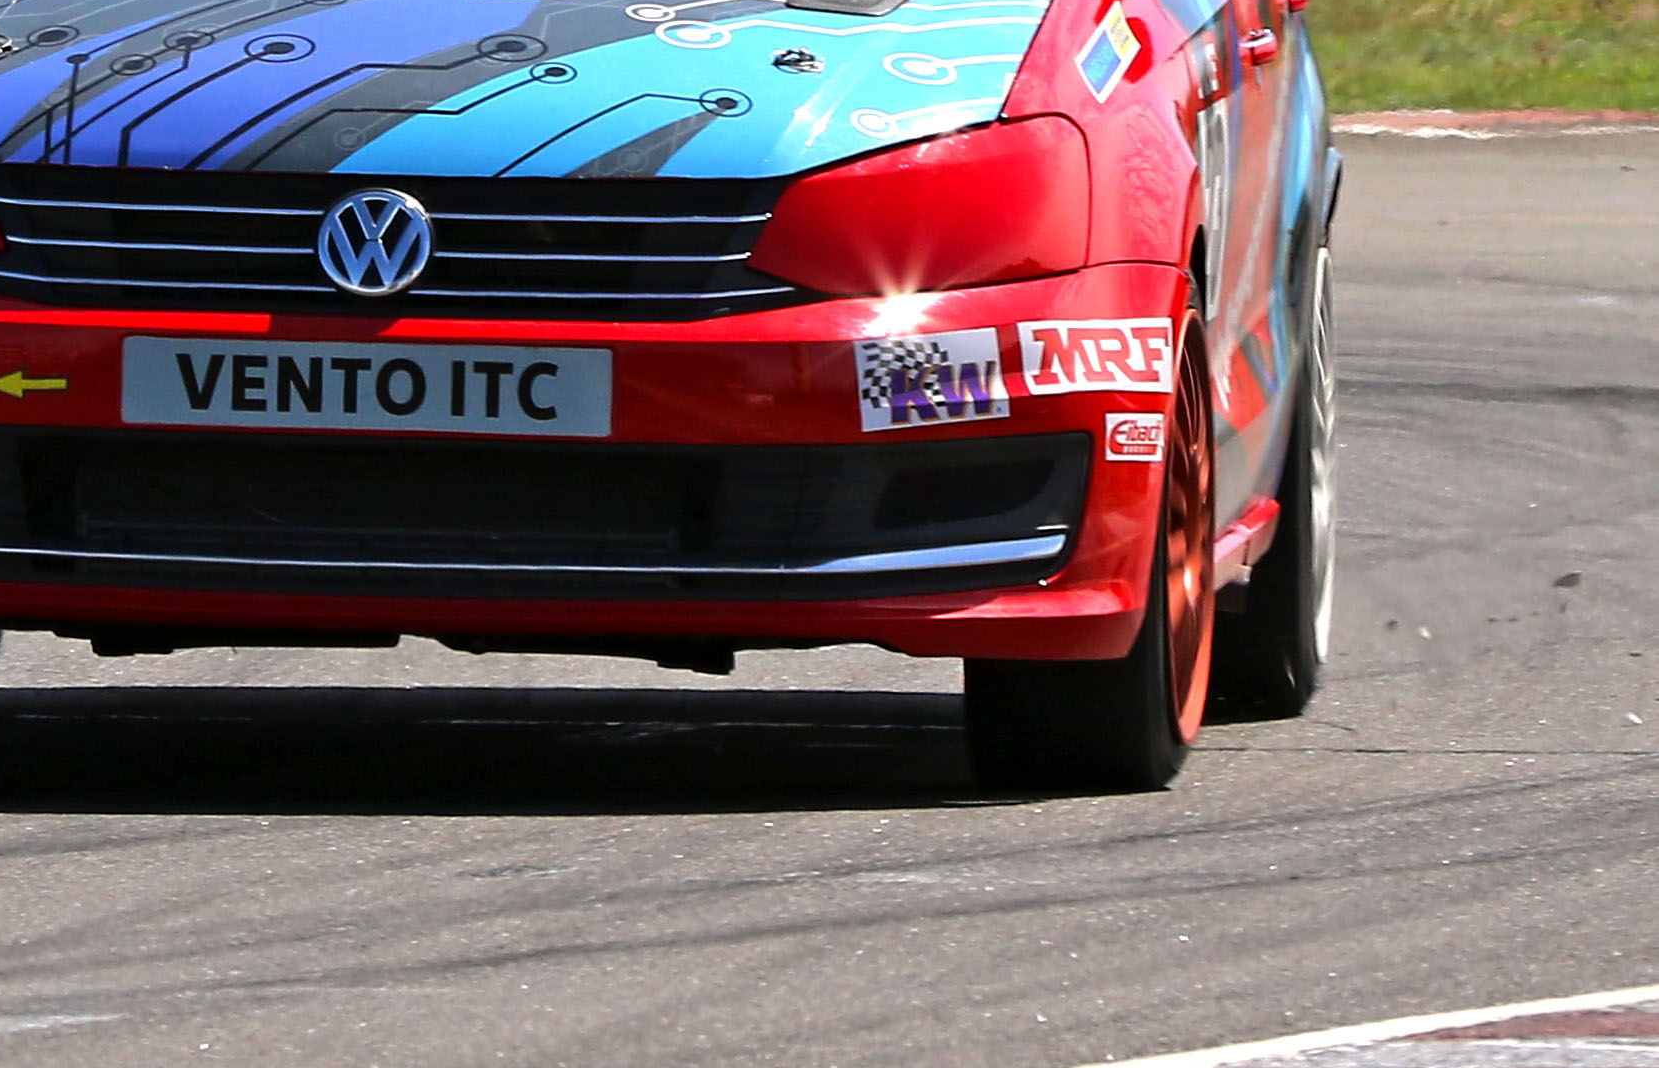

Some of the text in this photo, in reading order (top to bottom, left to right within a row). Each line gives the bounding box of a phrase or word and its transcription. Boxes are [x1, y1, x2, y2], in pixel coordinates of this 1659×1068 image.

[176, 352, 559, 422] VENTO ITC
[1031, 326, 1170, 386] MRF
[891, 359, 997, 424] KW
